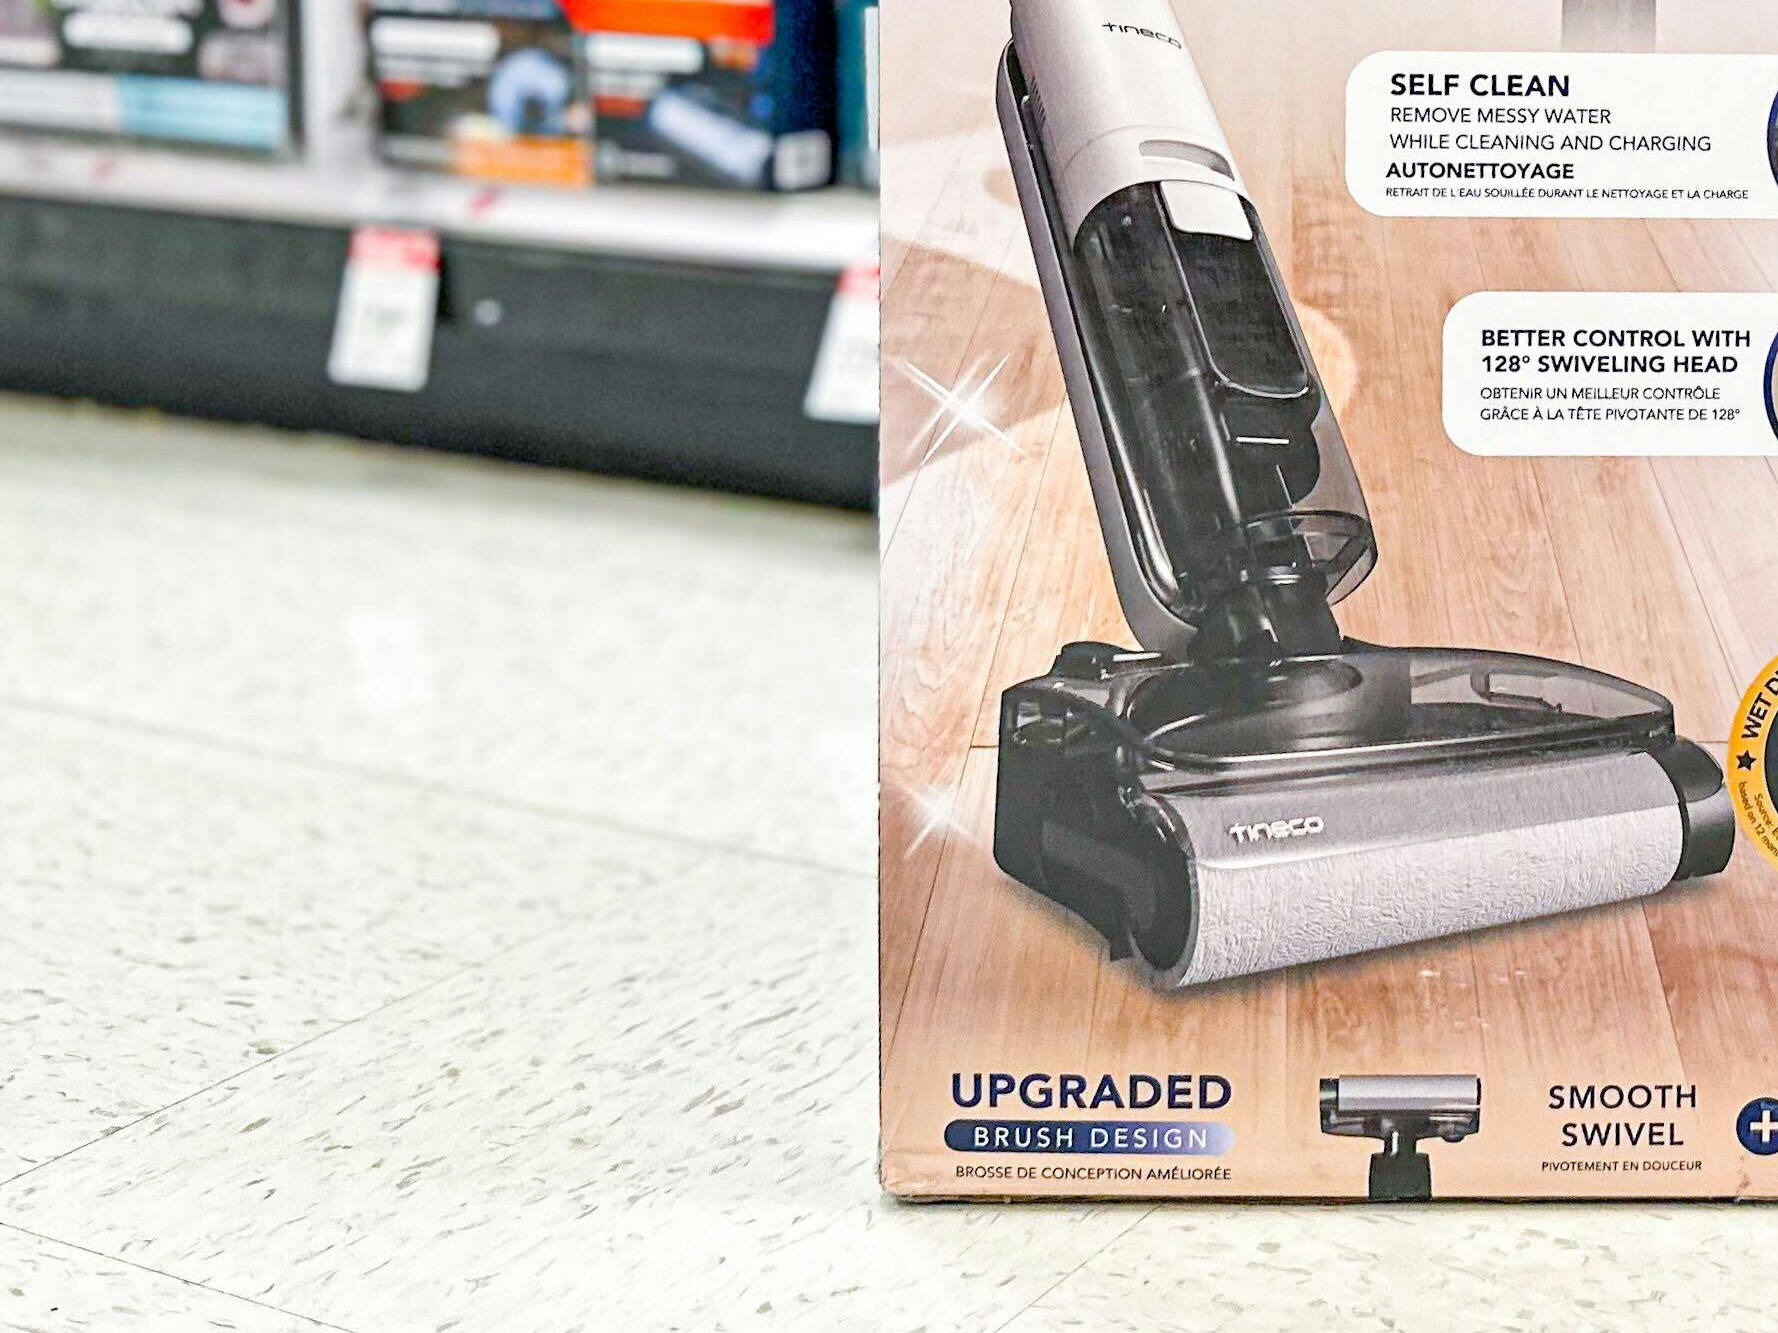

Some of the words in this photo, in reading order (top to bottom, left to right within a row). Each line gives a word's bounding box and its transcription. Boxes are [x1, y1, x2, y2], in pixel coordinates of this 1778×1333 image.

[1390, 72, 1460, 98] SELF
[1468, 73, 1571, 98] CLEAN
[1390, 106, 1474, 125] REMOVE
[1477, 107, 1541, 125] MESSY
[1543, 107, 1612, 125] WATER
[1388, 133, 1452, 151] WHILE
[1455, 133, 1556, 152] CLEANING
[1559, 134, 1603, 152] AND
[1607, 134, 1712, 153] CHARGING
[1385, 161, 1576, 181] AUTONETTOYAGE
[1385, 187, 1429, 198] RETRAIT
[1431, 187, 1447, 198] DE
[1484, 185, 1536, 199] SOUILLÉE
[1538, 188, 1584, 199] DURANT
[1586, 188, 1599, 199] LE
[1601, 188, 1669, 200] NETTOYAGE
[1671, 189, 1683, 200] ET
[1685, 189, 1701, 200] LA
[1702, 189, 1750, 200] CHARGE
[1481, 329, 1566, 348] BETTER
[1572, 329, 1685, 348] CONTROL
[1692, 330, 1752, 349] WITH
[1481, 355, 1531, 374] 128°
[1537, 355, 1667, 374] SWIVELING
[1672, 355, 1739, 374] HEAD
[1480, 386, 1543, 401] OBTENIR
[1545, 386, 1568, 401] UN
[1570, 387, 1641, 401] MEILLEUR
[1642, 383, 1721, 401] CONTRÔLE
[1480, 406, 1530, 422] GRÂCE
[1533, 405, 1546, 422] À
[1546, 408, 1564, 422] LA
[1566, 406, 1602, 422] TÊTE
[1604, 407, 1685, 422] PIVOTANTE
[1686, 407, 1709, 422] DE
[1740, 692, 1772, 741] WET
[951, 1072, 1233, 1110] UPGRADED
[1547, 1083, 1698, 1111] SMOOTH
[973, 1125, 1075, 1149] BRUSH
[1089, 1126, 1209, 1150] DESIGN
[1560, 1121, 1685, 1148] SWIVEL
[955, 1165, 1014, 1179] BROSSE
[1016, 1166, 1038, 1179] DE
[1041, 1166, 1143, 1181] CONCEPTION
[1146, 1164, 1233, 1181] AMÉLIORÉE
[1541, 1161, 1619, 1172] PIVOTEMENT
[1621, 1161, 1639, 1172] EN
[1641, 1161, 1703, 1172] DOUCEUR
